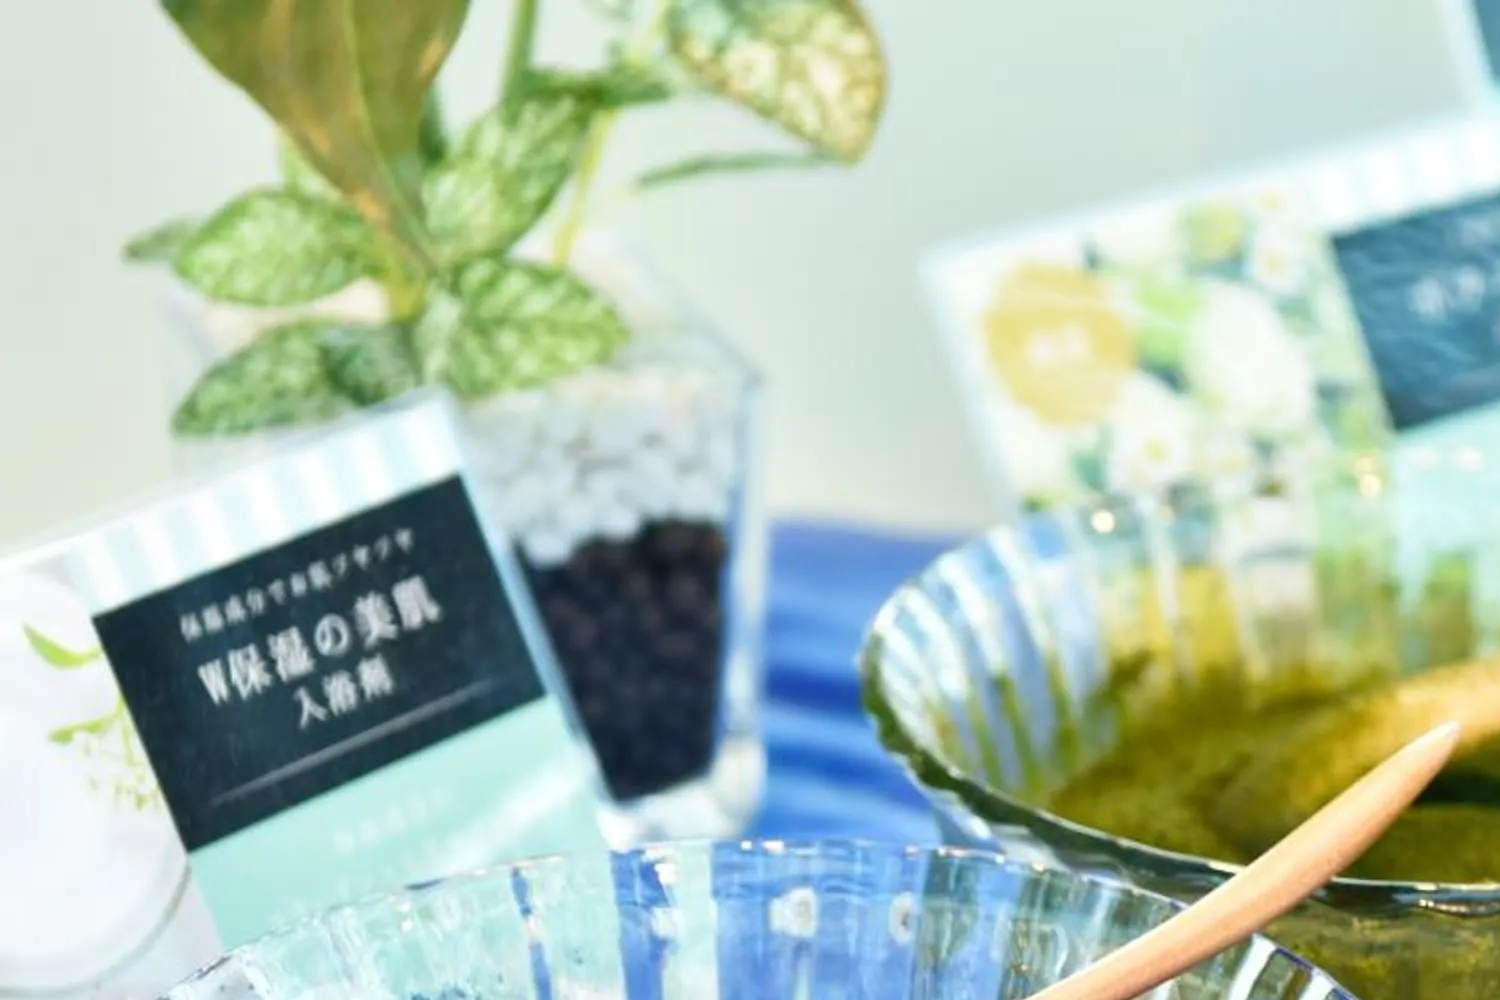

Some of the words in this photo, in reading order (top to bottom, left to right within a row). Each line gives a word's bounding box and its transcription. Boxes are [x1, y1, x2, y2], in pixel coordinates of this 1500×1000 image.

[197, 575, 442, 706] W保湿の美肌
[293, 653, 397, 730] 入浴剤
